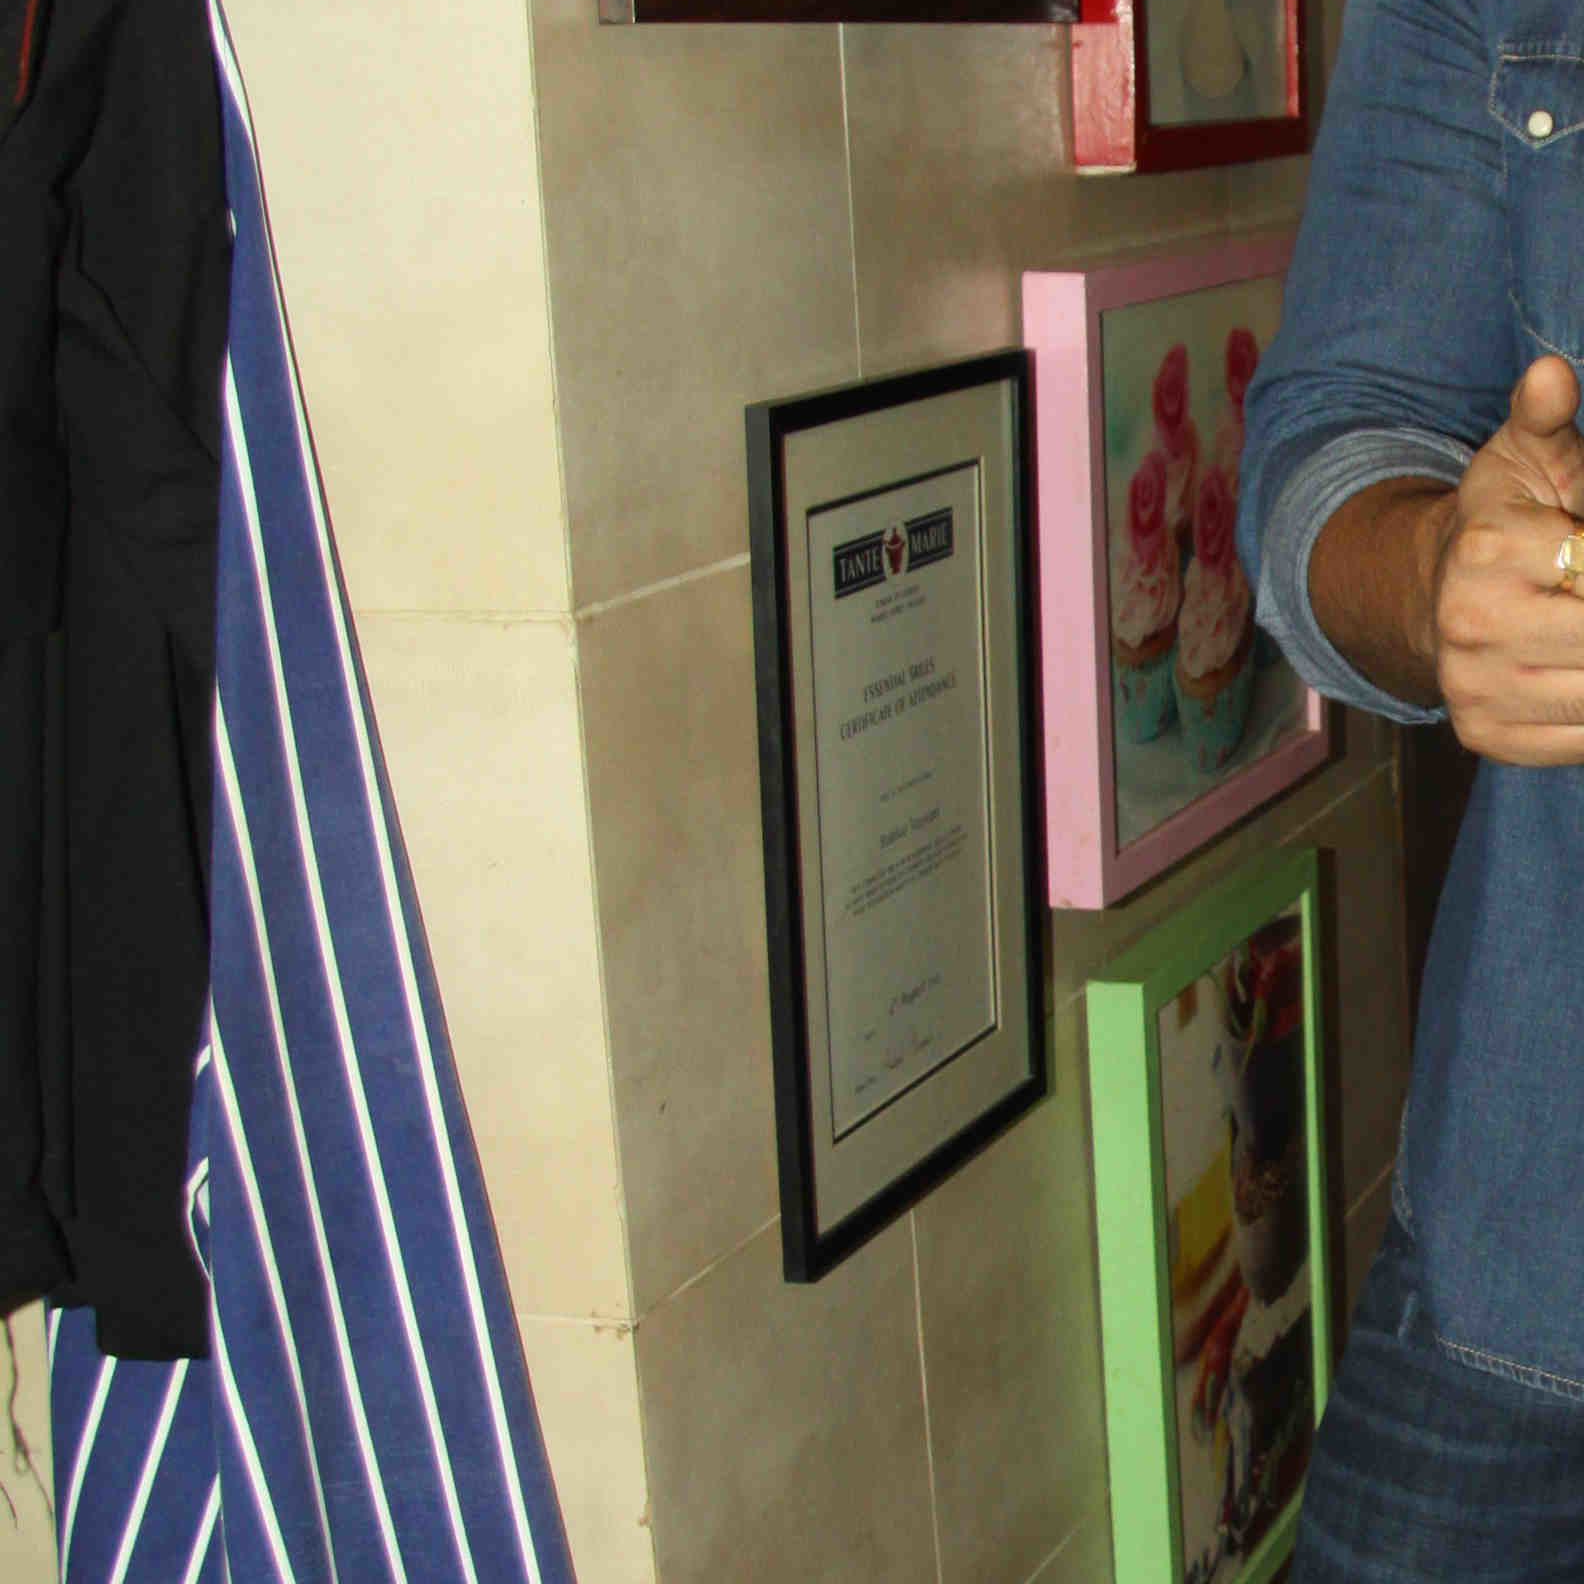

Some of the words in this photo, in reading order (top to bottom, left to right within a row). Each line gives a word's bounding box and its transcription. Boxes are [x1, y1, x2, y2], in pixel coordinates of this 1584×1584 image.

[839, 543, 881, 584] TANTE
[911, 520, 949, 554] MARIE
[840, 703, 892, 741] CERTIFICATE
